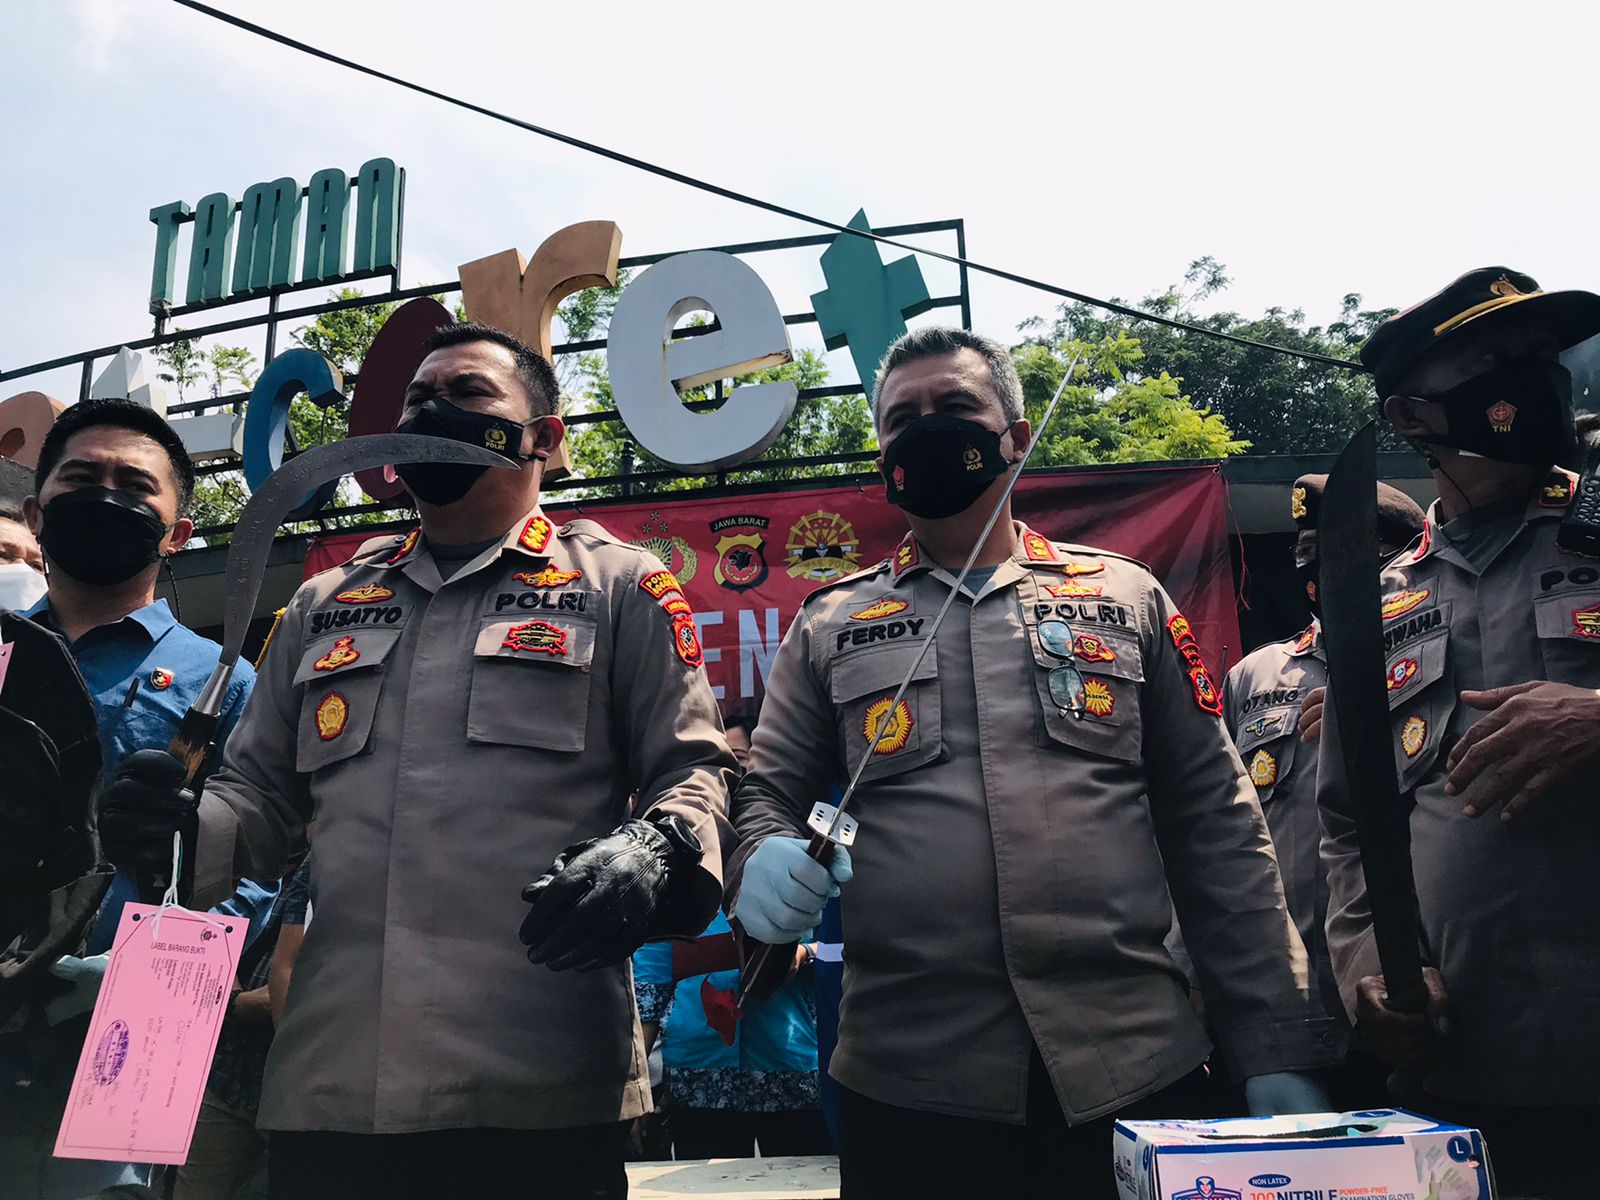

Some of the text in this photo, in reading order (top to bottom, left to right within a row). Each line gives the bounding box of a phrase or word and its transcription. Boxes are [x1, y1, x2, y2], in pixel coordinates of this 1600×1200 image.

[149, 157, 402, 312] TAMAN
[1492, 424, 1511, 433] TNI
[485, 441, 505, 451] POLRI
[714, 517, 766, 530] JAWA BARAT
[1540, 566, 1600, 591] PO
[495, 591, 587, 613] POLRI
[310, 606, 402, 634] SUSATYO
[1034, 603, 1127, 625] POLRI
[836, 618, 925, 651] FERDY
[1243, 689, 1299, 713] OTANG
[151, 942, 206, 955] LABEL BARANG BUKTI
[1454, 1140, 1465, 1154] L
[1251, 1177, 1288, 1185] NON LATEX
[1276, 1189, 1338, 1200] NITRILE
[1339, 1186, 1388, 1194] POWDER-FREE
[1389, 1192, 1415, 1200] GLOVES
